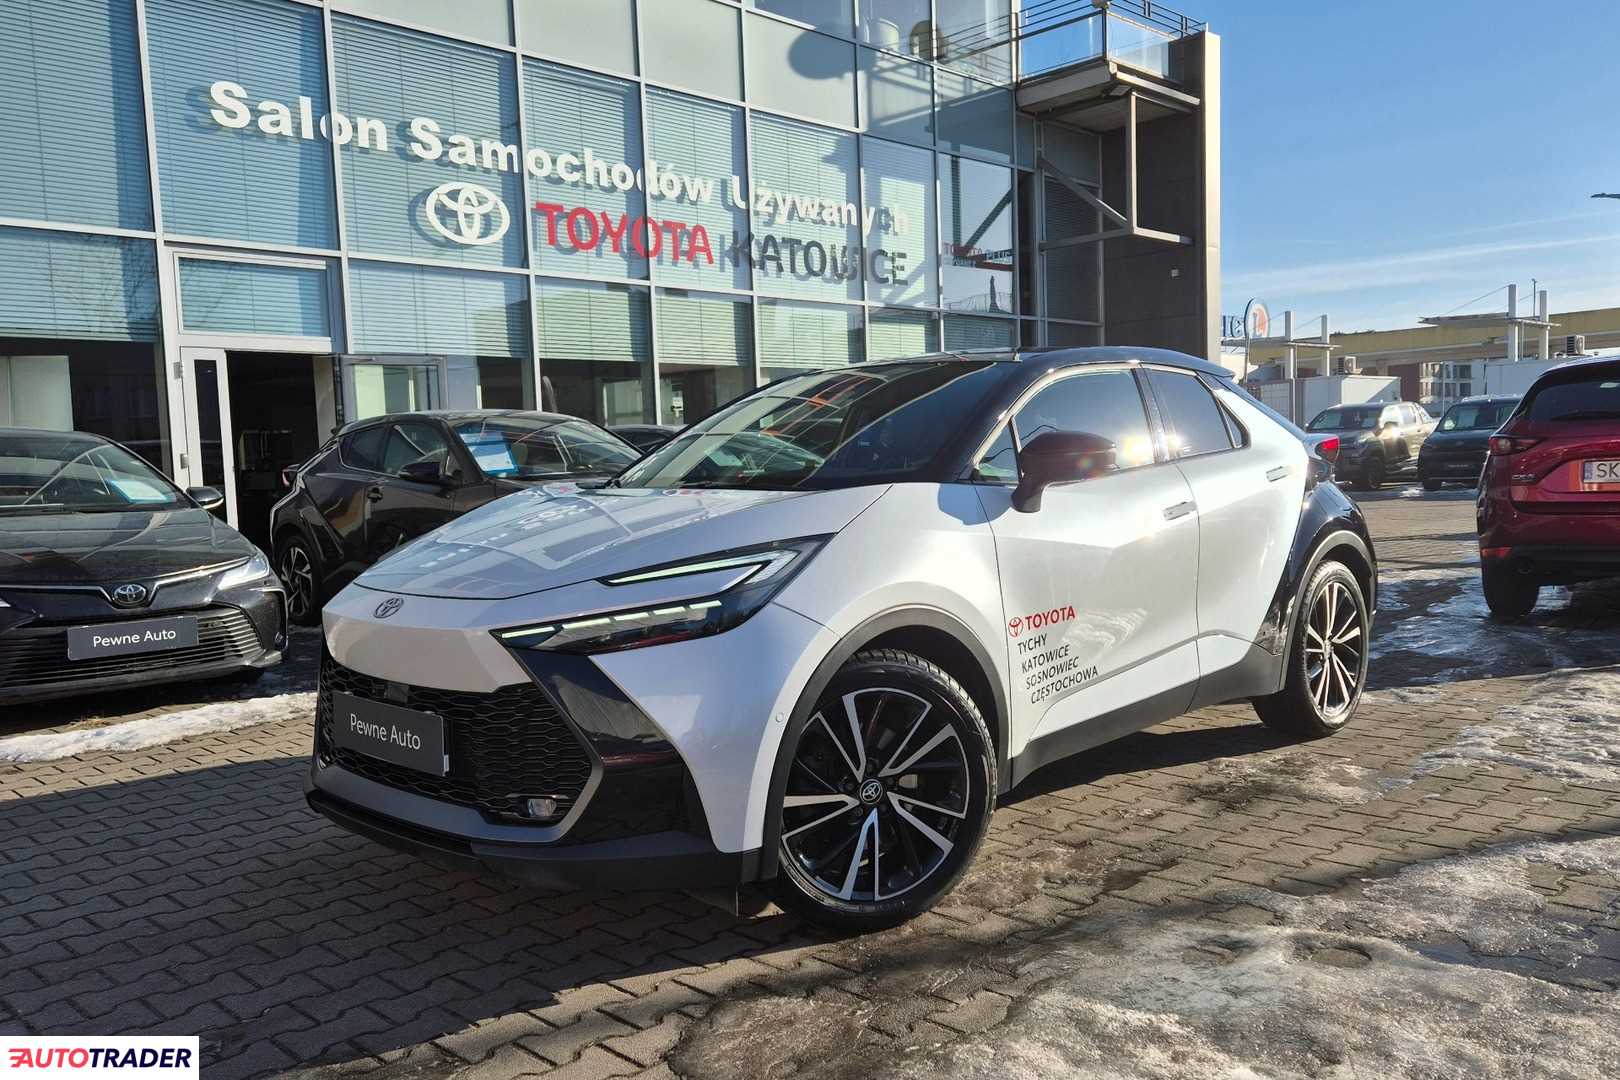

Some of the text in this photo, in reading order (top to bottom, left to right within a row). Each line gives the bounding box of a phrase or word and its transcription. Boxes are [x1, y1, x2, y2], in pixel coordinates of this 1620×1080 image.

[209, 80, 388, 152] Salon
[410, 116, 713, 203] Samochodów
[535, 200, 715, 265] TOYOTA
[732, 230, 908, 286] KATOWICE
[1024, 605, 1076, 630] TOYOTA
[93, 629, 176, 648] Pewne Auto
[1017, 633, 1047, 655] TYCHY
[1021, 644, 1070, 674] KATOWICE
[1026, 656, 1079, 690] SOSNOWIEC
[1031, 665, 1098, 704] CZĘSTOCHOWA
[350, 713, 421, 750] Pewne Auto
